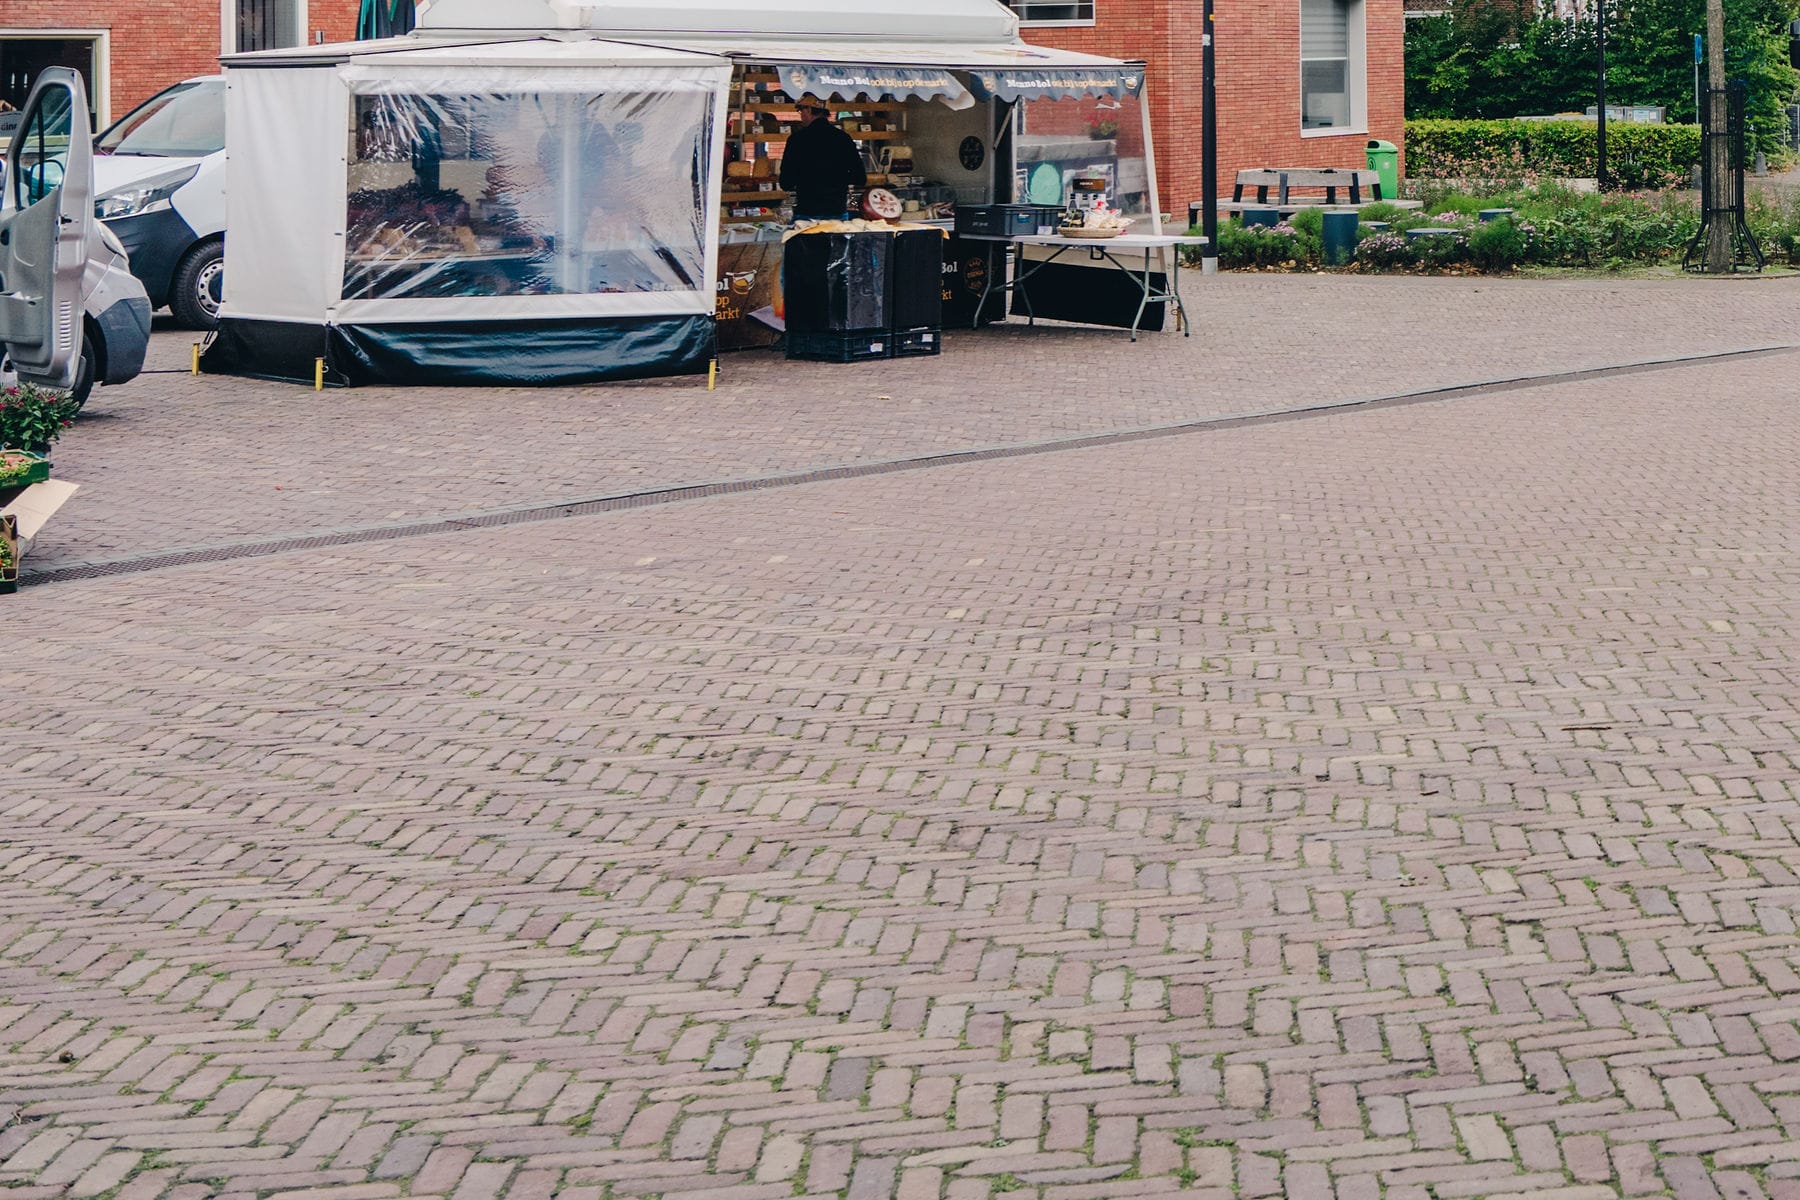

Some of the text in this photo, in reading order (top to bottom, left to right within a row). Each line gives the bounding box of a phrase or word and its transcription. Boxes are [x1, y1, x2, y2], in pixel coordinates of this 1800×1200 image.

[820, 75, 854, 86] Menno
[902, 79, 915, 89] op
[1006, 79, 1035, 88] Menno
[715, 307, 741, 321] arkt
